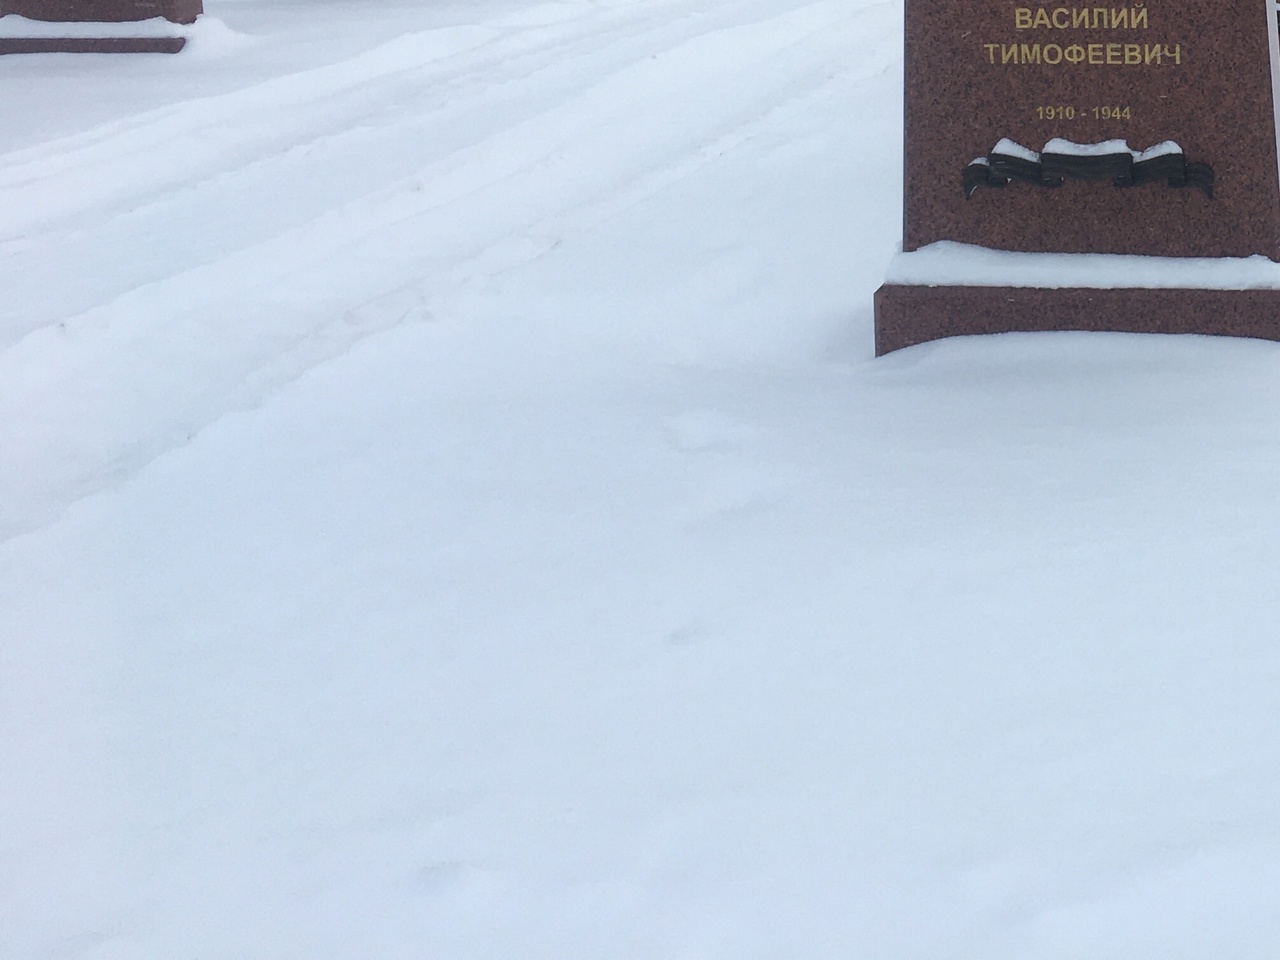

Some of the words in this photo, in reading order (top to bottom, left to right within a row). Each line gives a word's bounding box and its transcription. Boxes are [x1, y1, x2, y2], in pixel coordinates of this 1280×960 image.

[1015, 3, 1148, 29] ВАСИЛИЙ
[984, 43, 1181, 65] ТИМОФЕЕВИЧ
[1036, 106, 1075, 120] 1910
[1092, 106, 1131, 120] 1944
